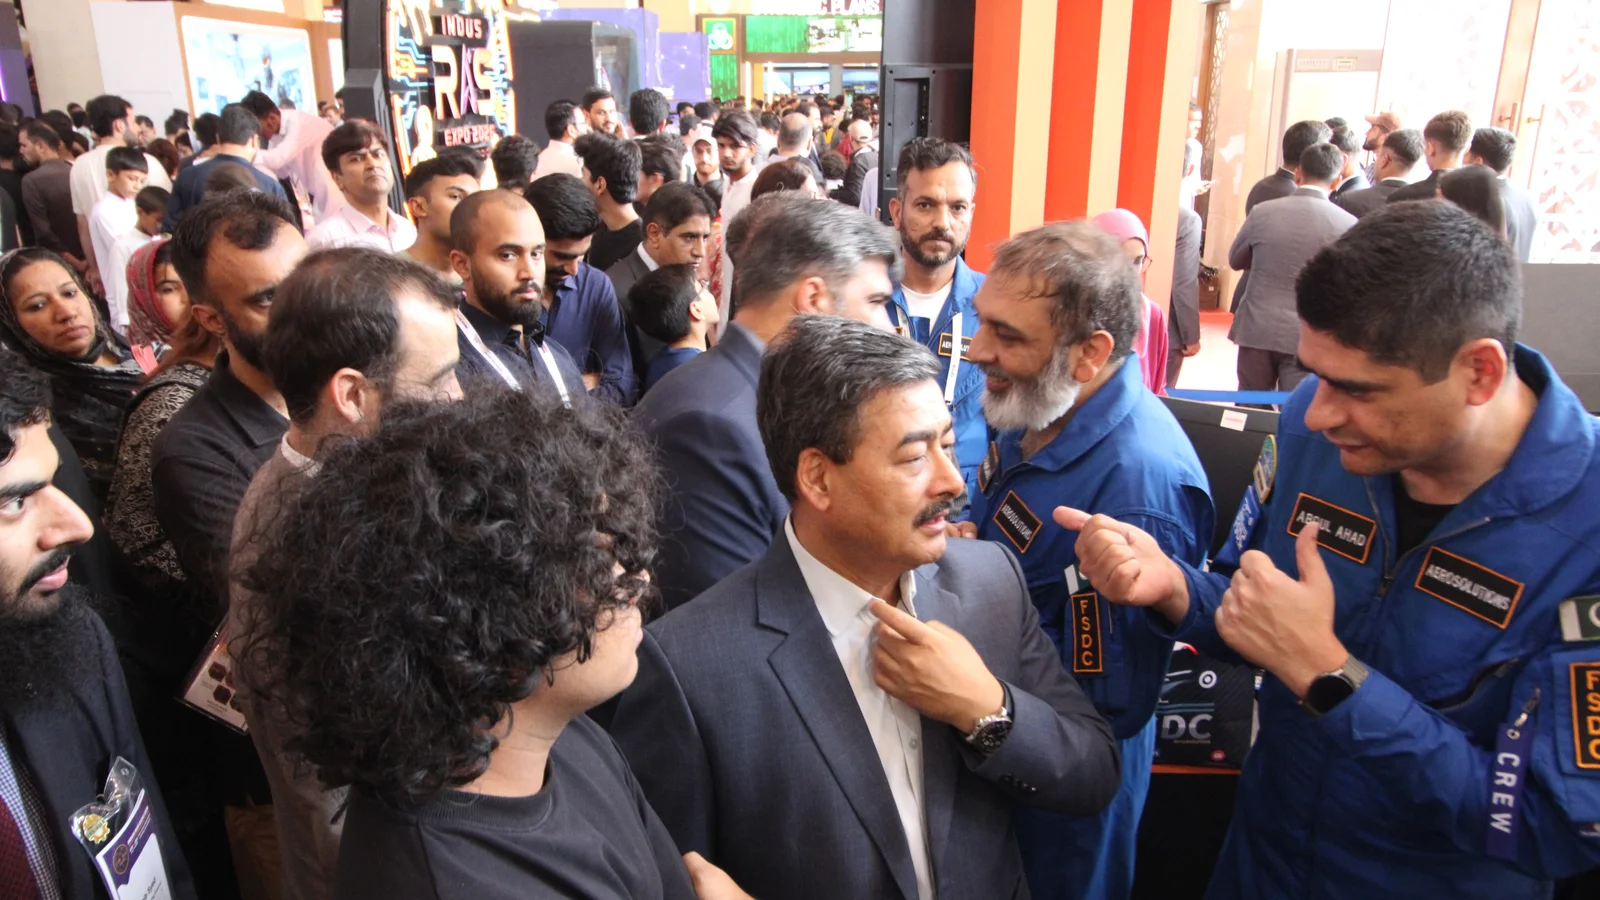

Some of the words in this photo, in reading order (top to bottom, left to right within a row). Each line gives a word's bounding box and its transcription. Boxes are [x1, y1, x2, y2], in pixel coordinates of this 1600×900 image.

[441, 14, 483, 39] INDUS
[444, 127, 471, 146] EXPO
[1335, 525, 1367, 547] AHAD
[1425, 564, 1511, 610] AEROSOLUTIONS
[1080, 599, 1093, 666] FSDC
[1161, 713, 1213, 739] DC
[1489, 752, 1521, 834] CREW
